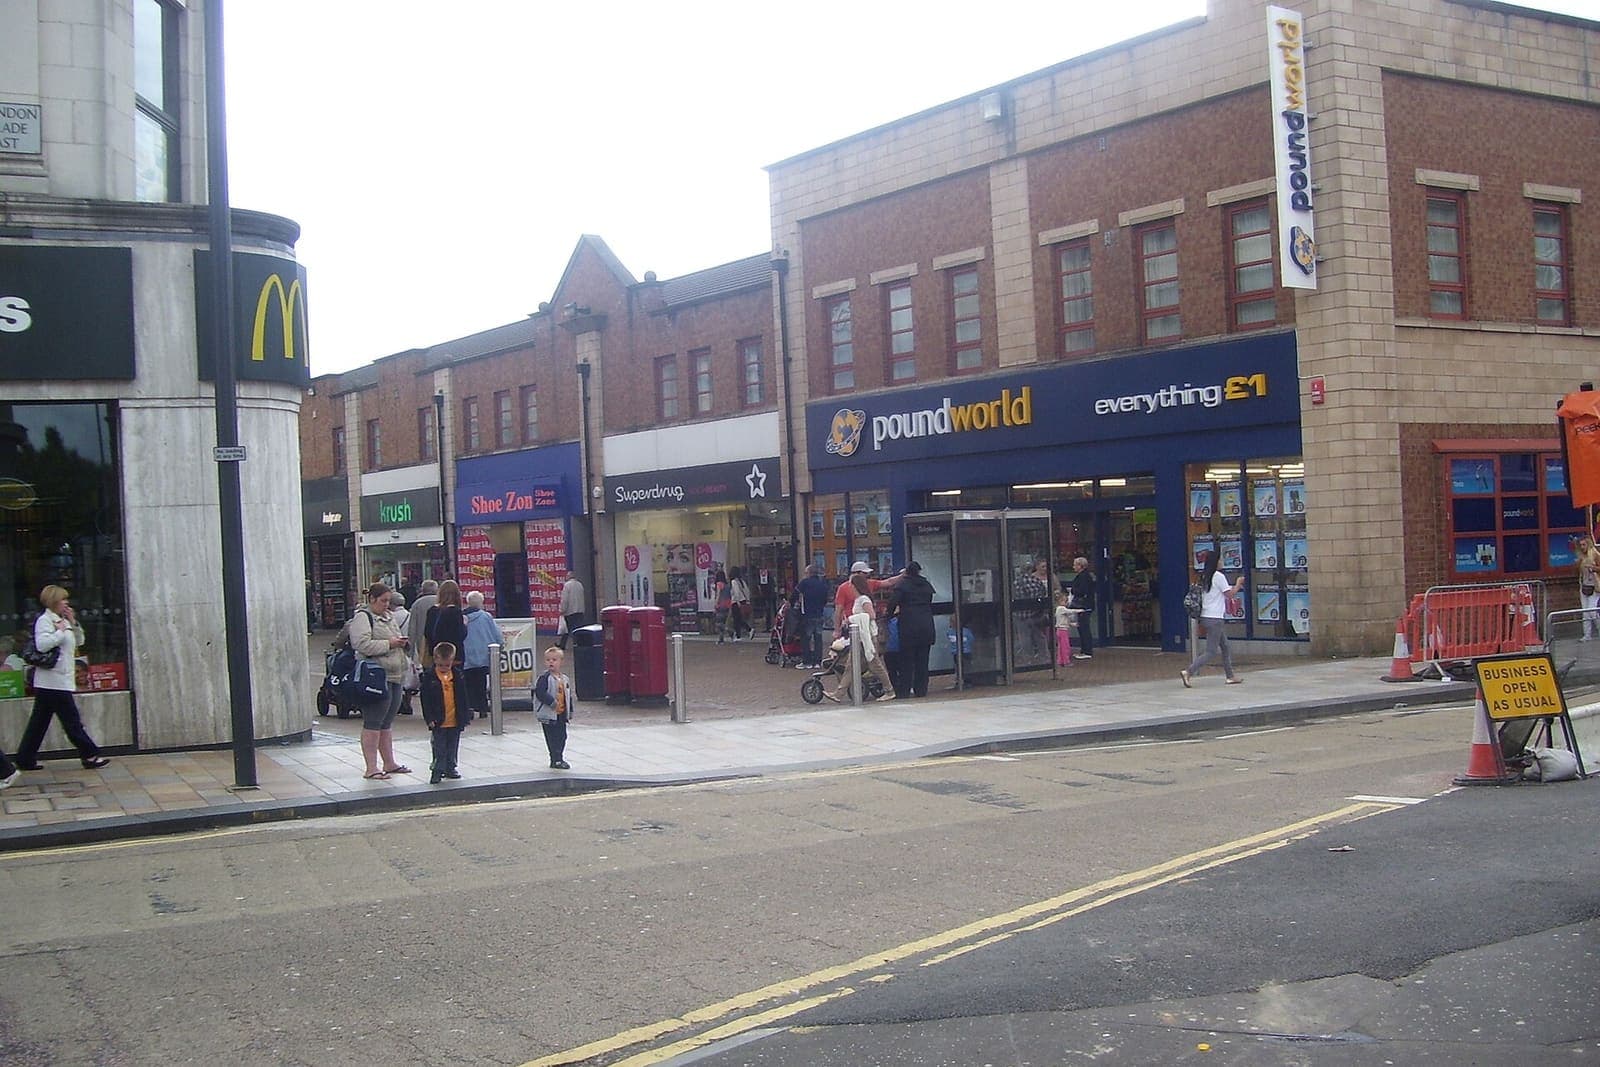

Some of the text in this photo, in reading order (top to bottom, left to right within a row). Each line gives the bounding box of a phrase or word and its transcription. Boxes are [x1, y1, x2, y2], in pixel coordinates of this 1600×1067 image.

[1276, 18, 1314, 212] poundworld
[0, 122, 29, 134] ADE
[1095, 373, 1268, 414] everything £1
[872, 386, 1033, 450] poundworld
[615, 484, 685, 504] Superdrug
[380, 497, 411, 523] krush
[471, 495, 502, 514] Shoe
[1483, 665, 1547, 680] BUSINESS
[1502, 681, 1537, 694] OPEN
[1493, 696, 1556, 711] AS USUAL
